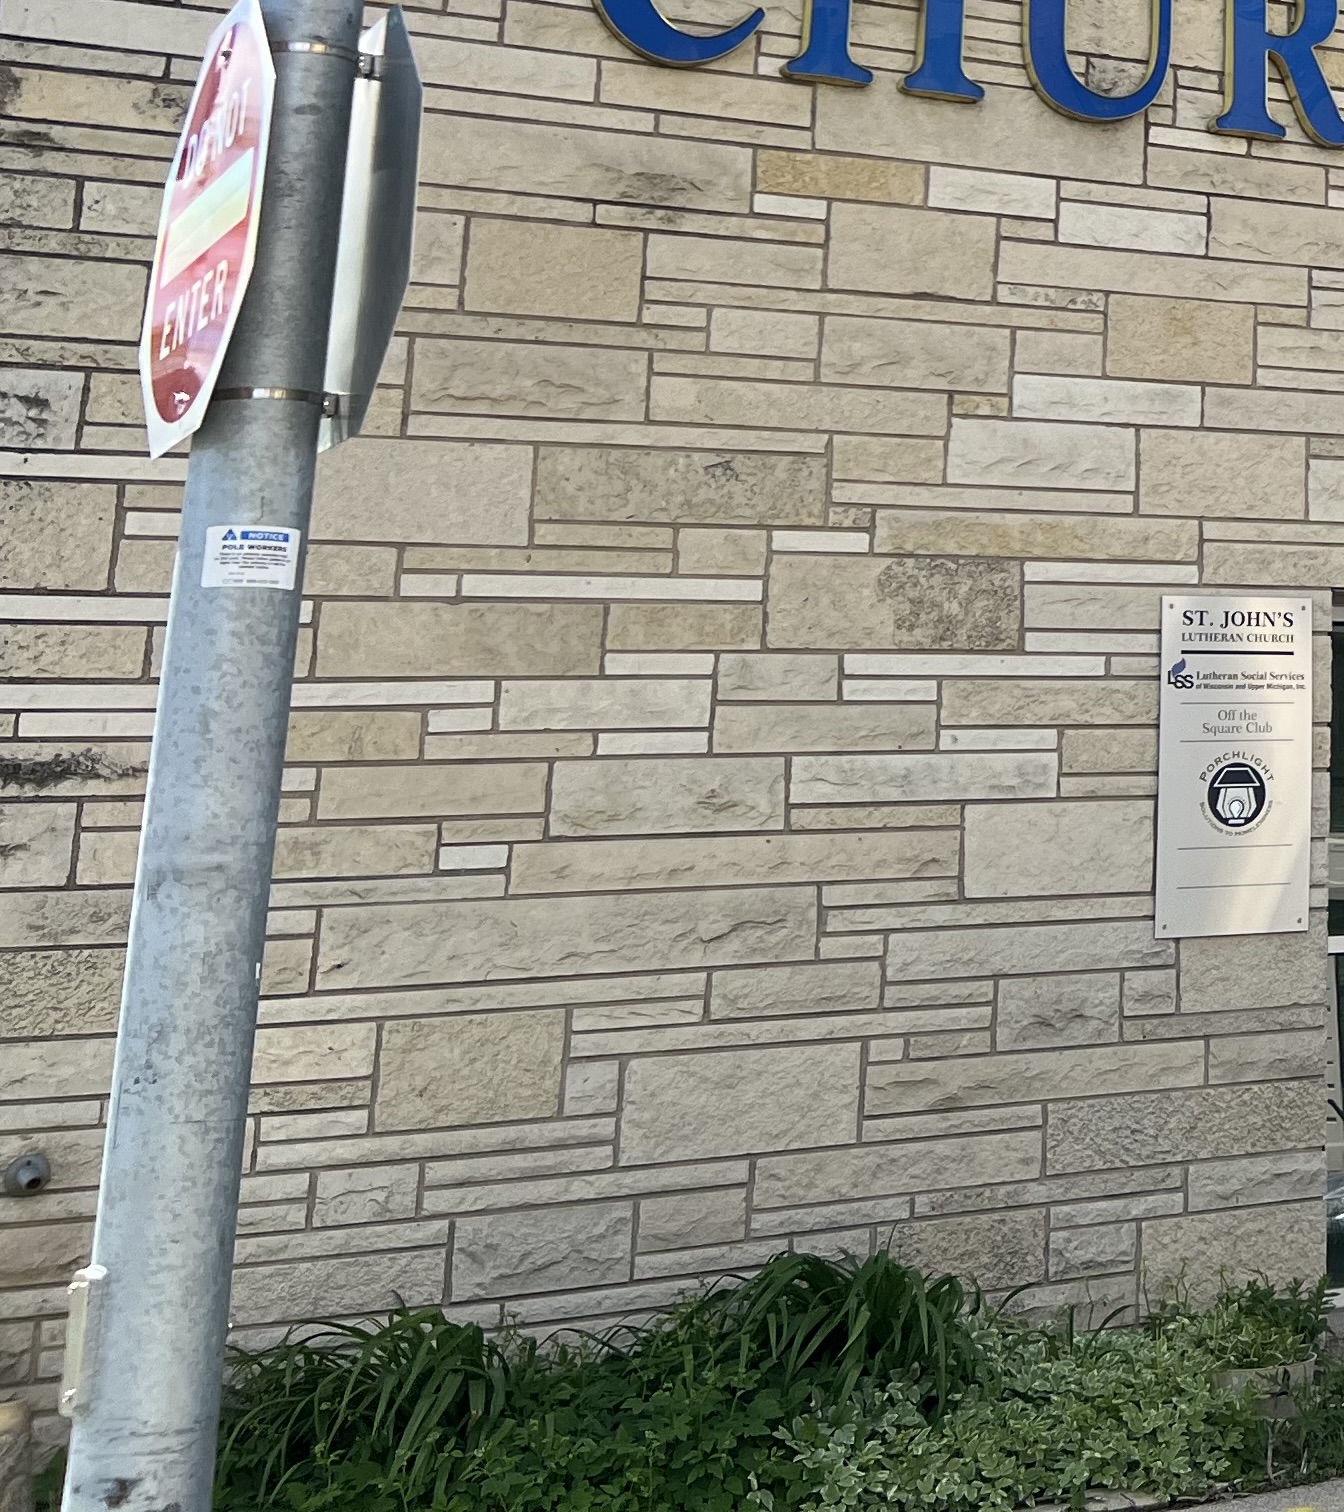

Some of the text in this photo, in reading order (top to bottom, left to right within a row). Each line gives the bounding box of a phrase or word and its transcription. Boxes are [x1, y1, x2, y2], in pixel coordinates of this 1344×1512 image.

[159, 259, 229, 361] ENTER
[248, 532, 285, 541] NOTICE
[1182, 610, 1294, 629] ST. JOHN'S
[1181, 632, 1294, 643] LUTHERAN CHURCH
[1167, 670, 1194, 689] LSS
[1196, 671, 1305, 681] Lutheran Social Services
[1217, 709, 1258, 721] Off the
[1202, 721, 1273, 736] Square Club
[1199, 750, 1275, 783] PORCHLIGHT
